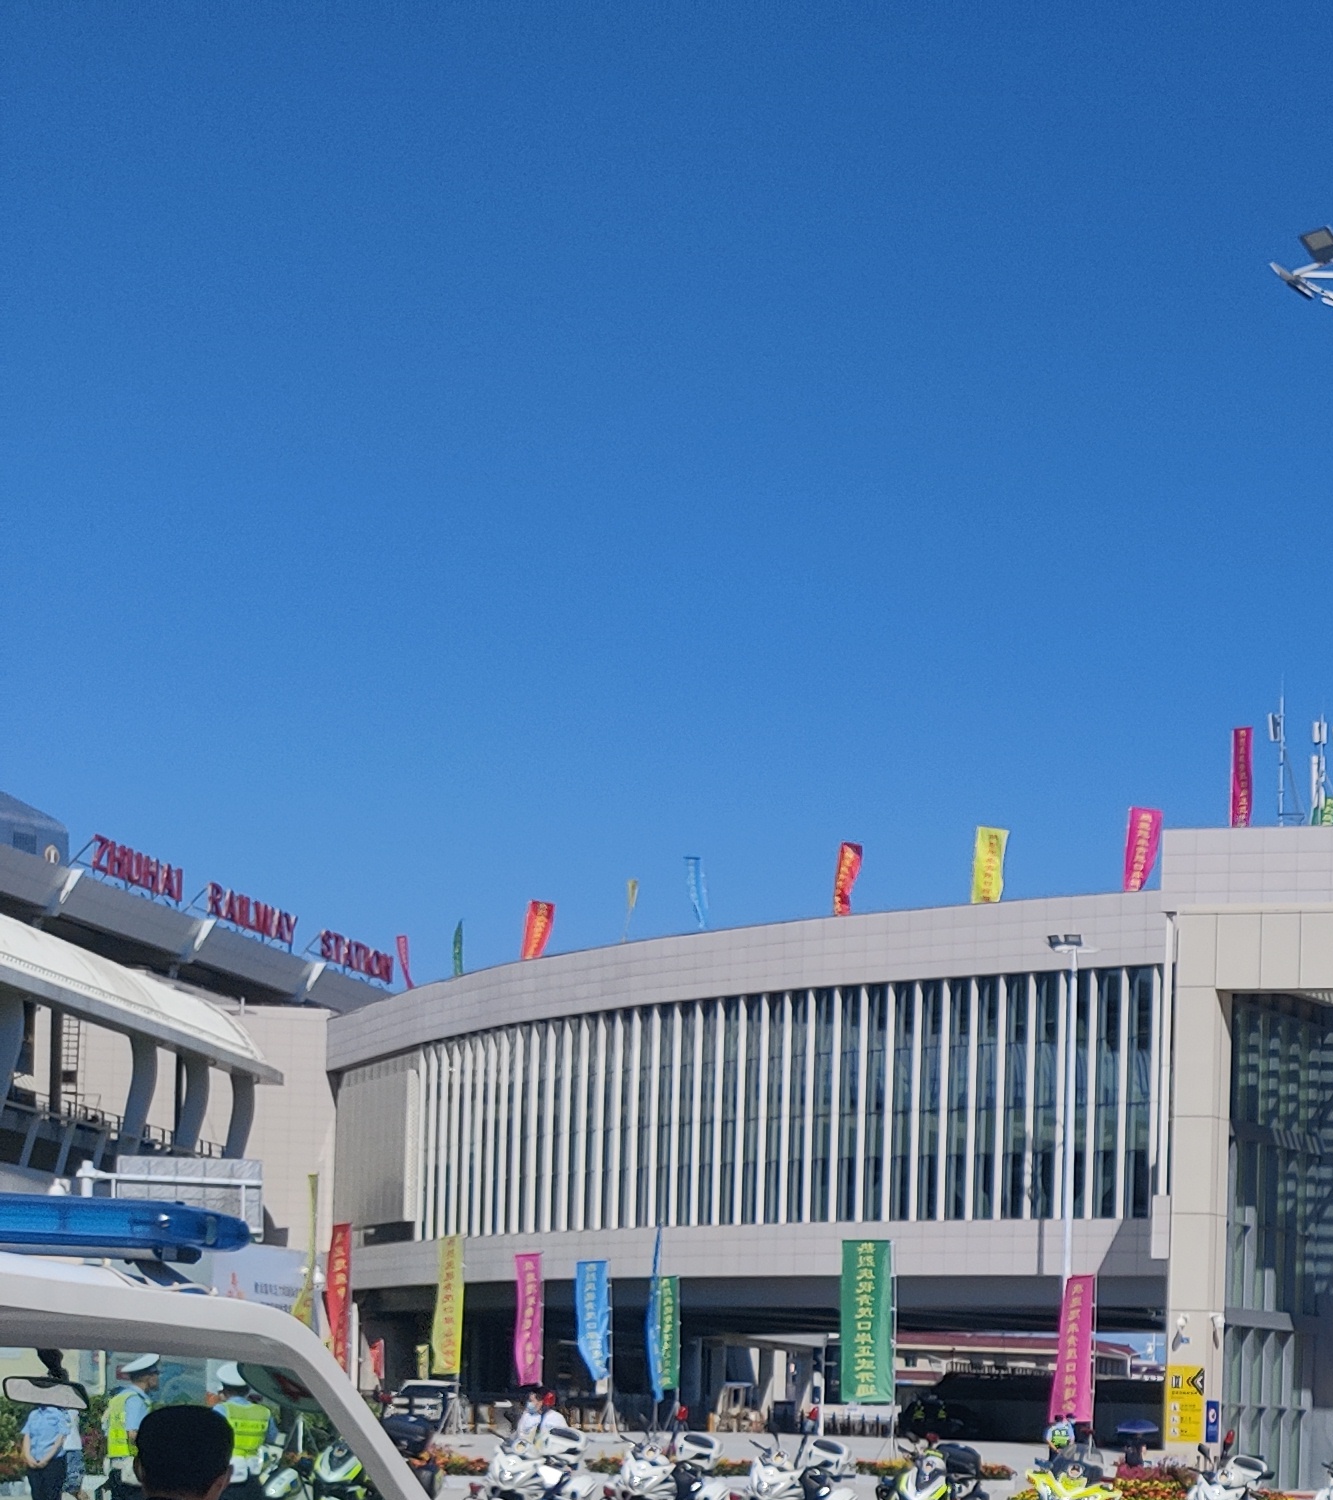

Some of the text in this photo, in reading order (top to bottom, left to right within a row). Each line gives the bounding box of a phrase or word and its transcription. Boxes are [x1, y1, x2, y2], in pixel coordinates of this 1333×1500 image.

[92, 834, 393, 983] ZHUHAI RAILWAY STATION
